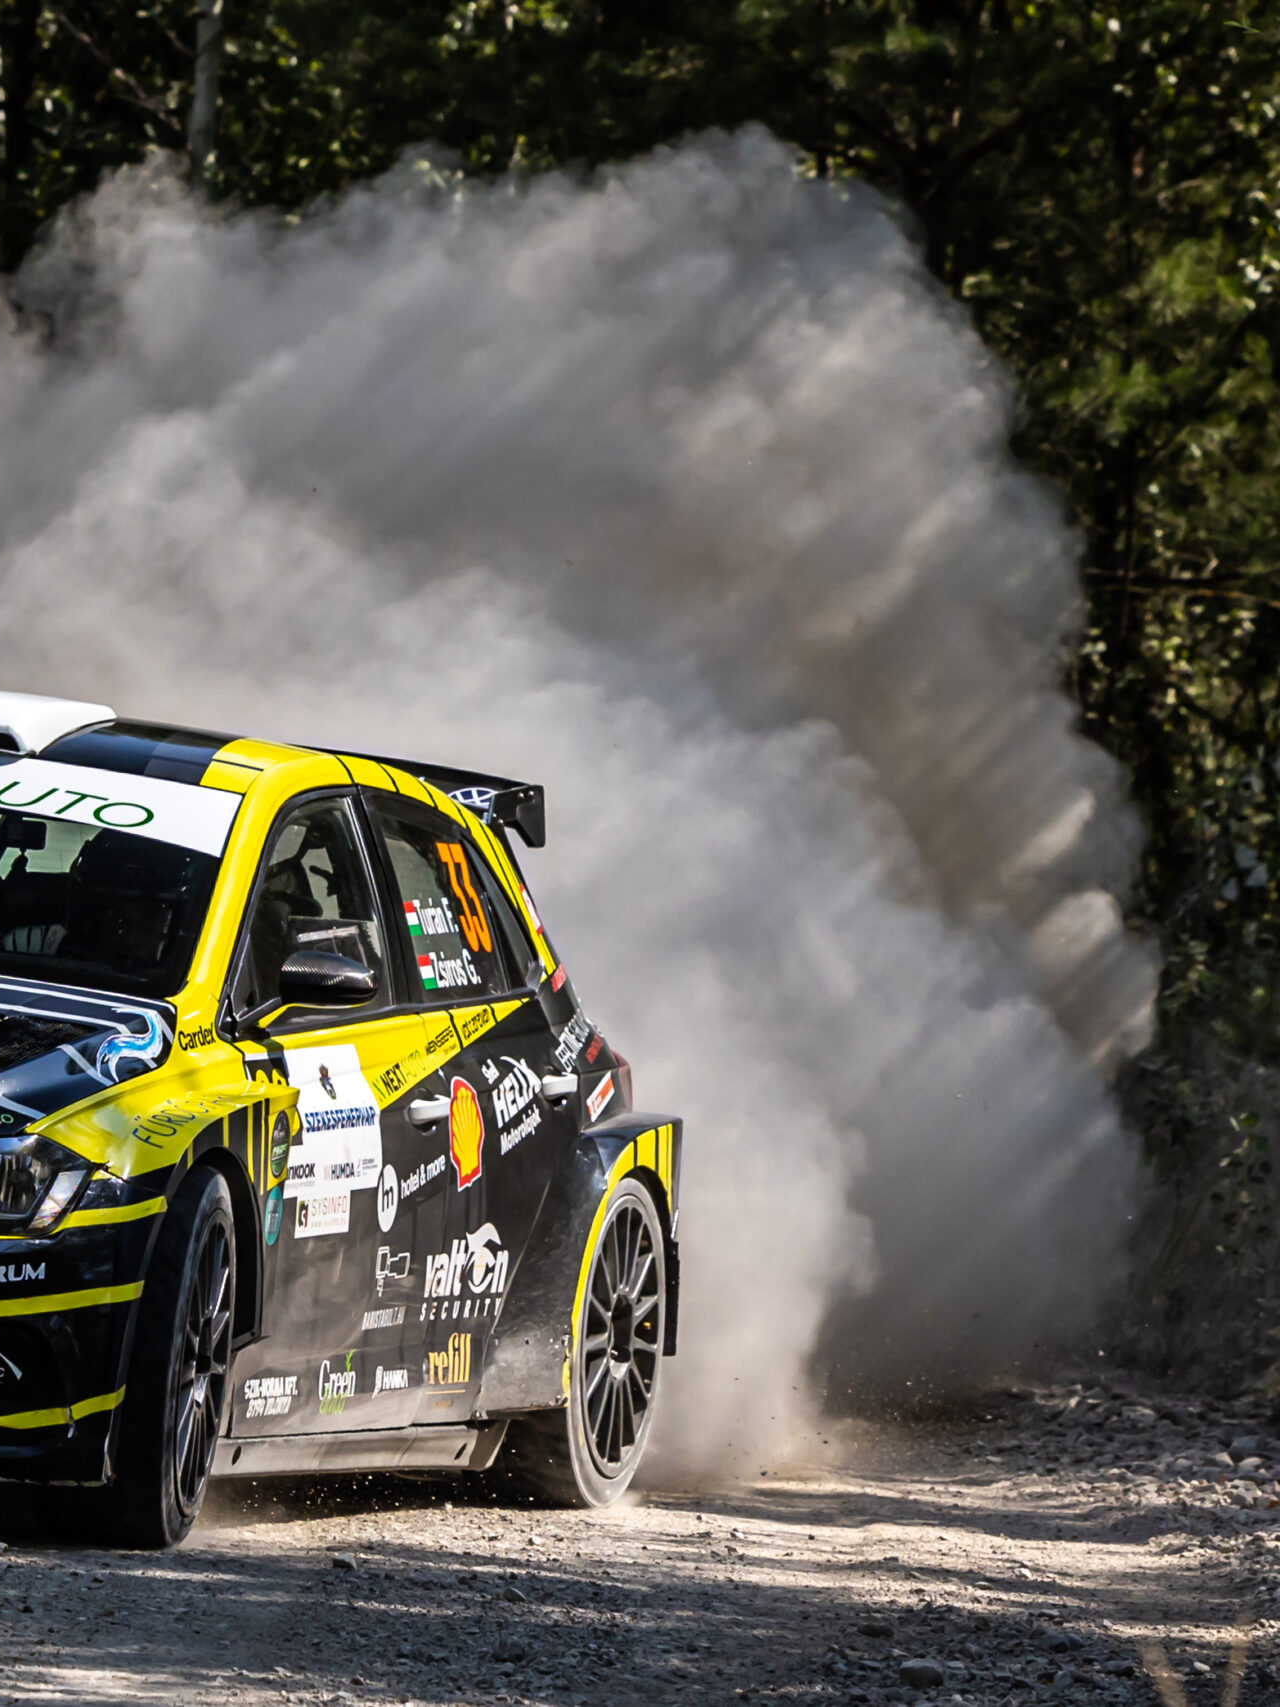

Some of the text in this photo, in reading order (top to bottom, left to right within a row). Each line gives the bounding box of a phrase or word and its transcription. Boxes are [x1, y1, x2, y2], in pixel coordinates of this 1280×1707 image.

[177, 1022, 216, 1052] Cardex
[401, 1174, 420, 1199] hotel
[426, 1154, 446, 1183] more
[420, 1298, 502, 1321] SECURITY
[428, 1333, 471, 1384] refill
[319, 1360, 356, 1400] Green
